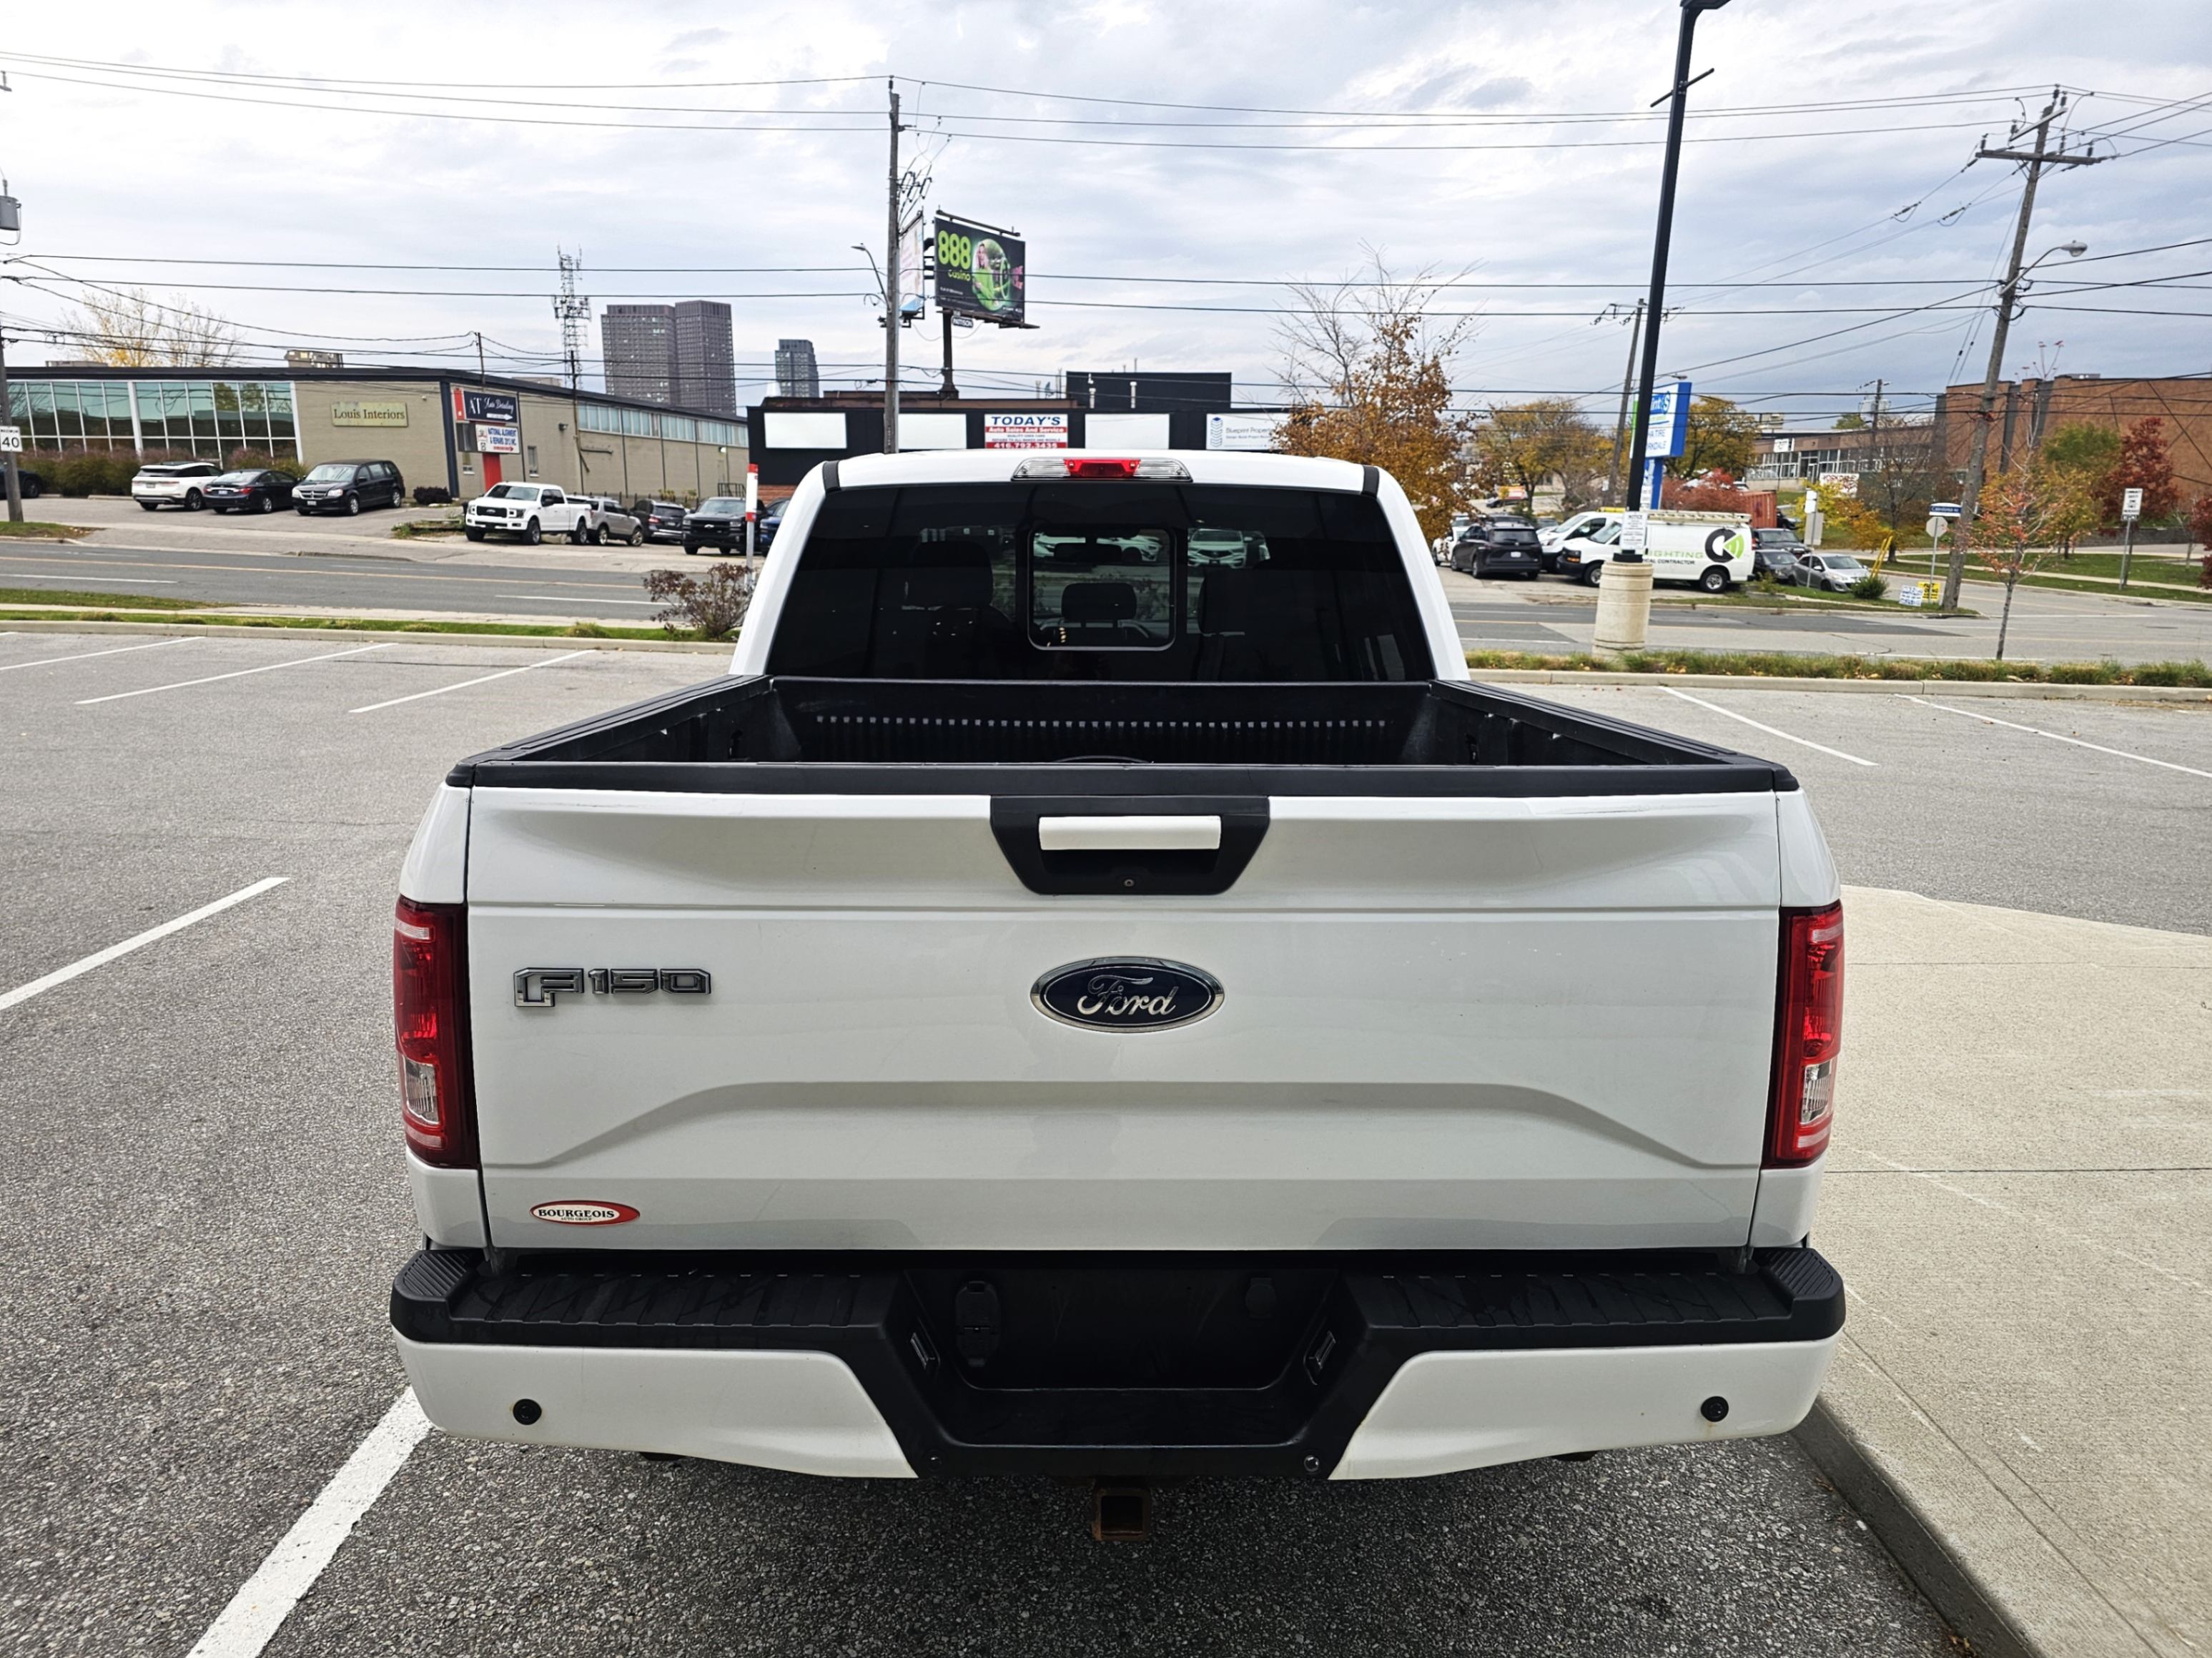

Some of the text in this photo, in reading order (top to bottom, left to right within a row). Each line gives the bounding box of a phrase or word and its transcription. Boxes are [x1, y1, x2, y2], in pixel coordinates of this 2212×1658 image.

[938, 230, 972, 270] 888
[947, 269, 971, 282] Casino
[333, 408, 406, 420] Louis Interiors
[992, 416, 1060, 425] TODAY'S
[2, 436, 20, 448] 40
[1077, 974, 1179, 1016] Ford
[538, 1209, 615, 1218] BOURGEOIS
